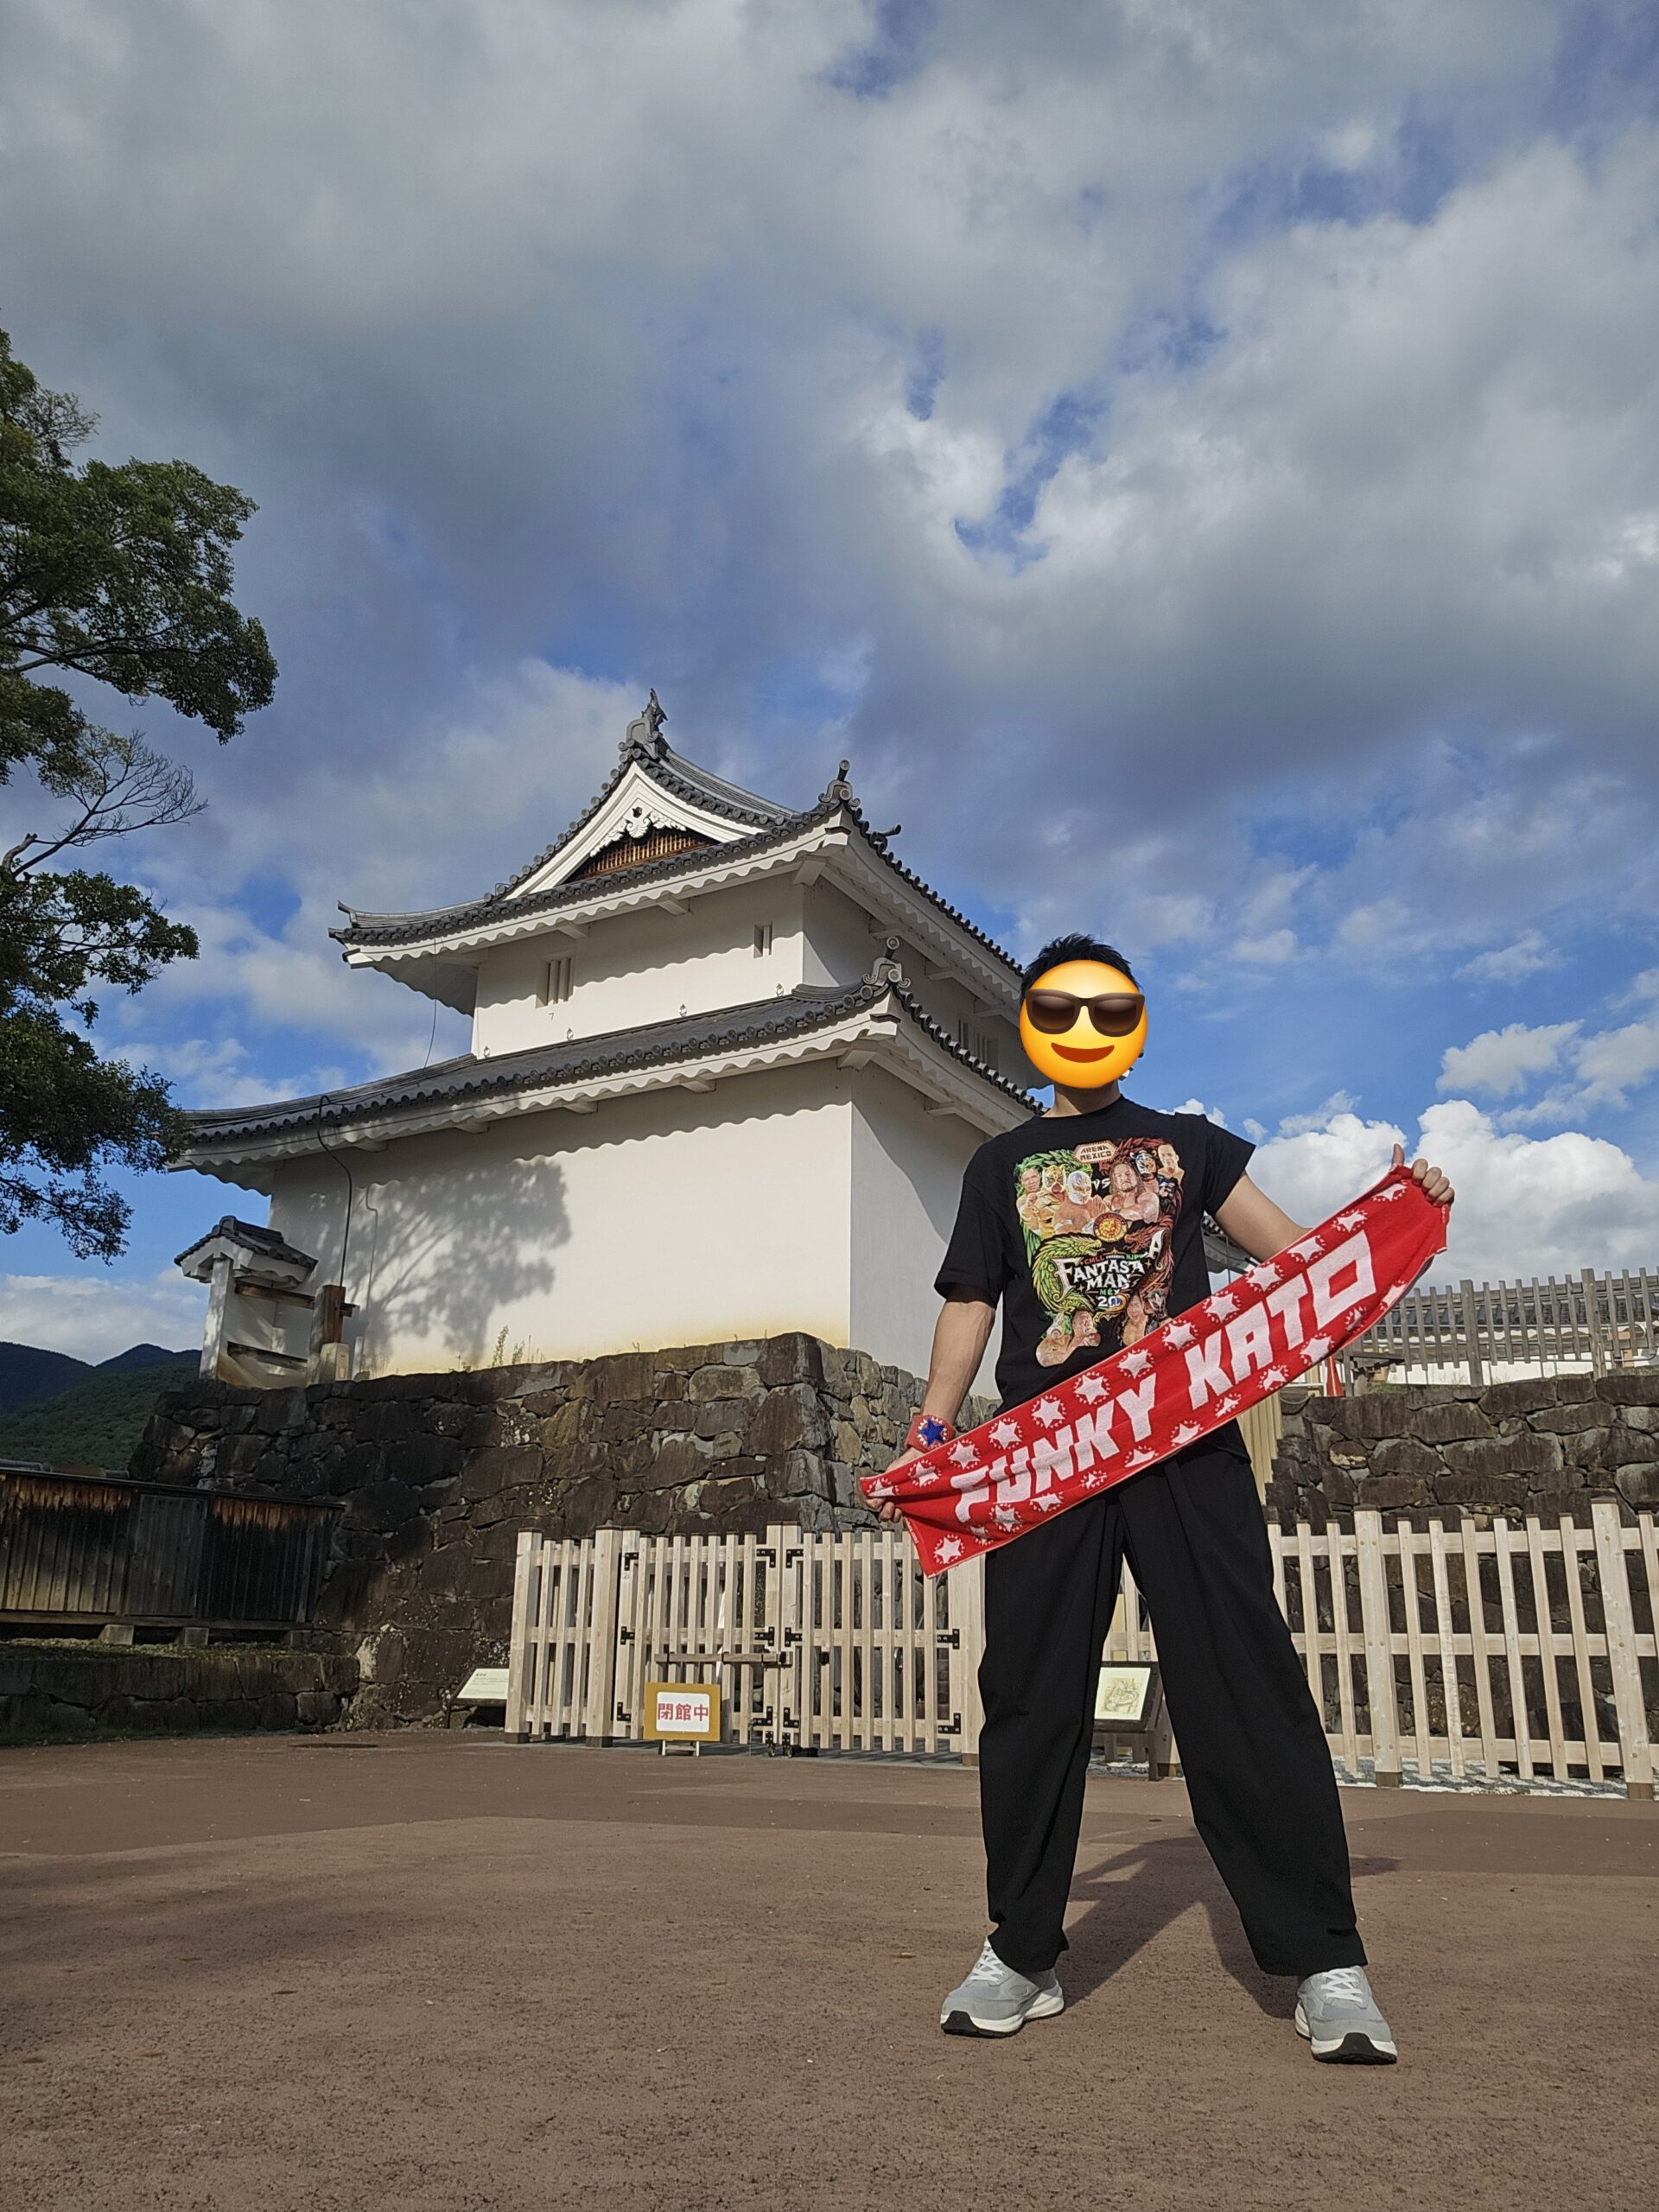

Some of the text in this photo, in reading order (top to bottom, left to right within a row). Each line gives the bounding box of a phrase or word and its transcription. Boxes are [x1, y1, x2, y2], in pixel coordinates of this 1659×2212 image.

[1080, 1151, 1112, 1160] MEXICO
[1081, 1145, 1109, 1154] ARENA
[1091, 1178, 1111, 1191] VS
[950, 1230, 1377, 1522] FUNKY KATO
[658, 1703, 709, 1721] 閉館中
